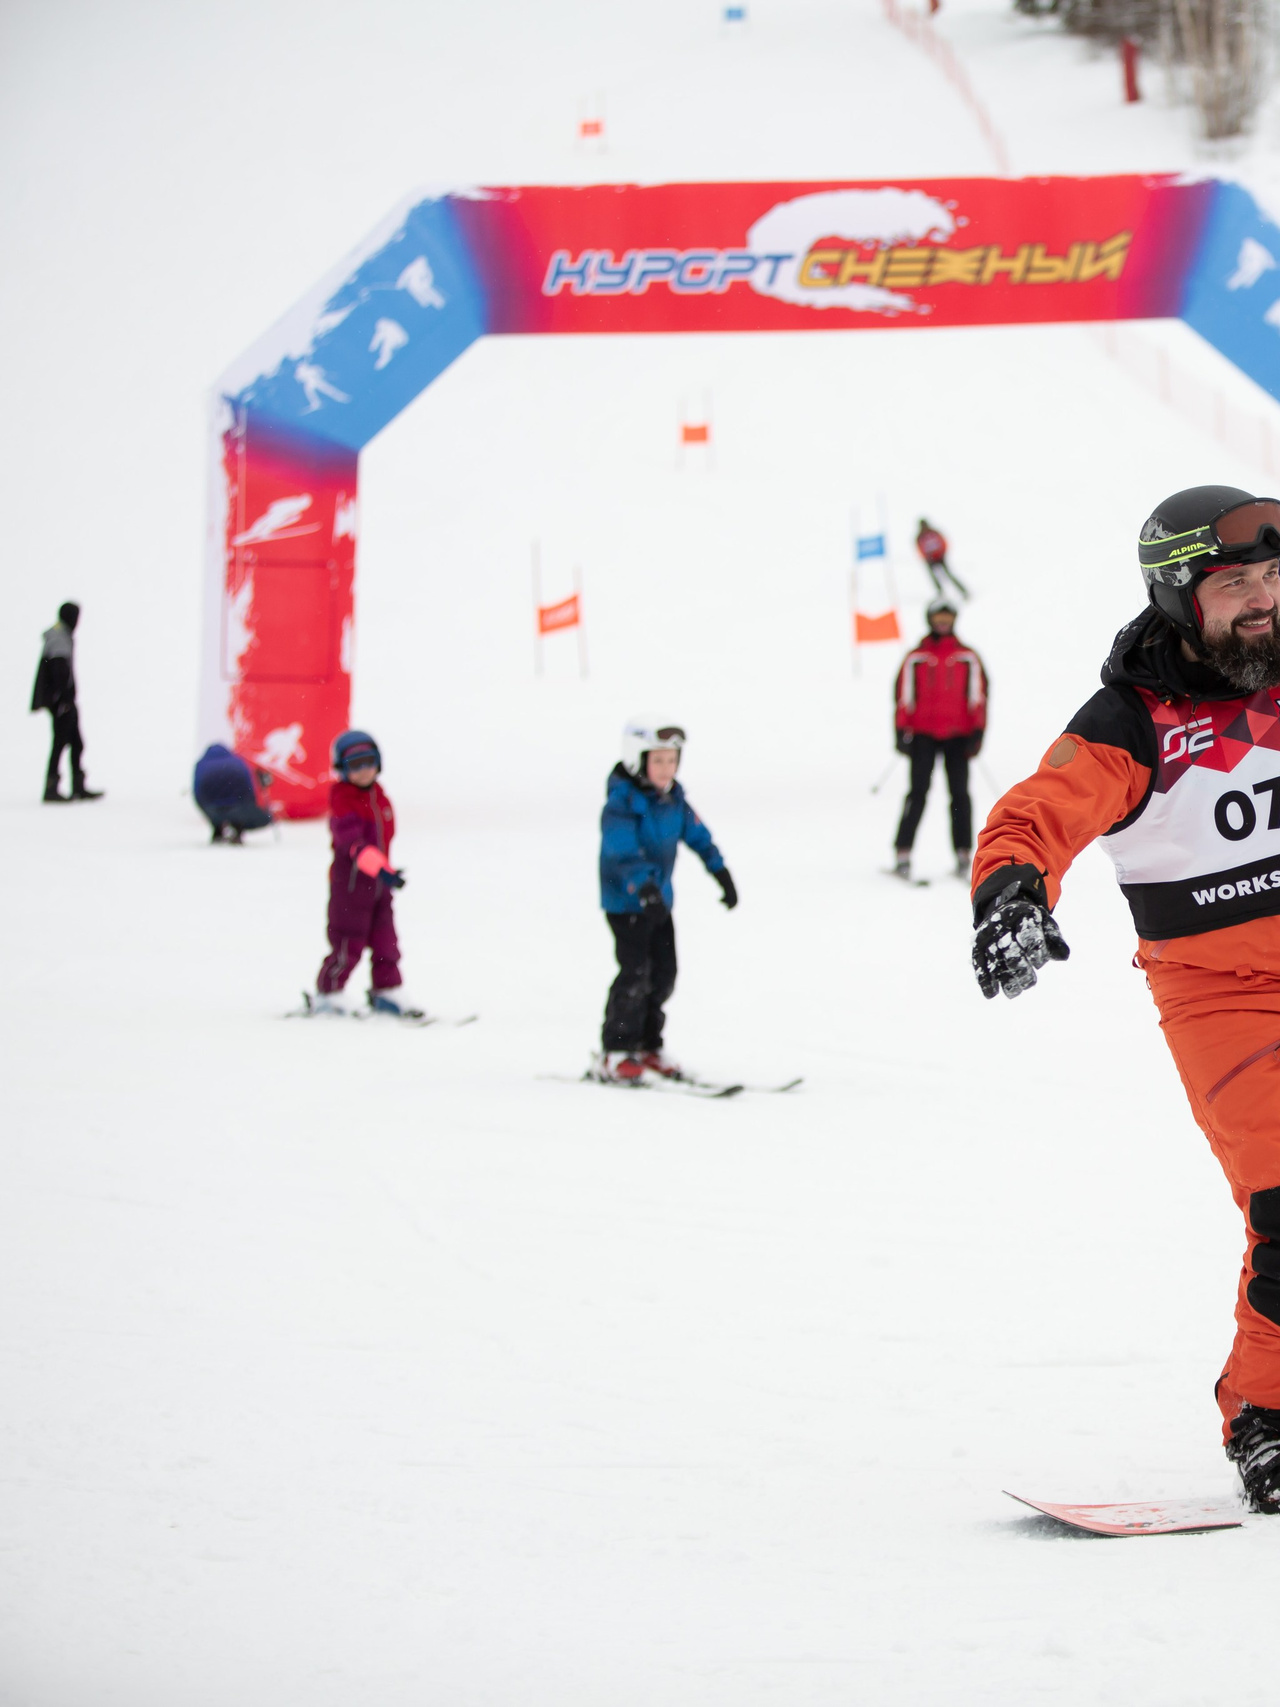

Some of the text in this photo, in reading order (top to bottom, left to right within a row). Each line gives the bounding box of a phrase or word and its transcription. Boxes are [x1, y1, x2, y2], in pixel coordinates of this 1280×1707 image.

[542, 230, 1132, 296] КУРОРТ СНЕЖНЫЙ
[1169, 542, 1208, 558] ALPINA
